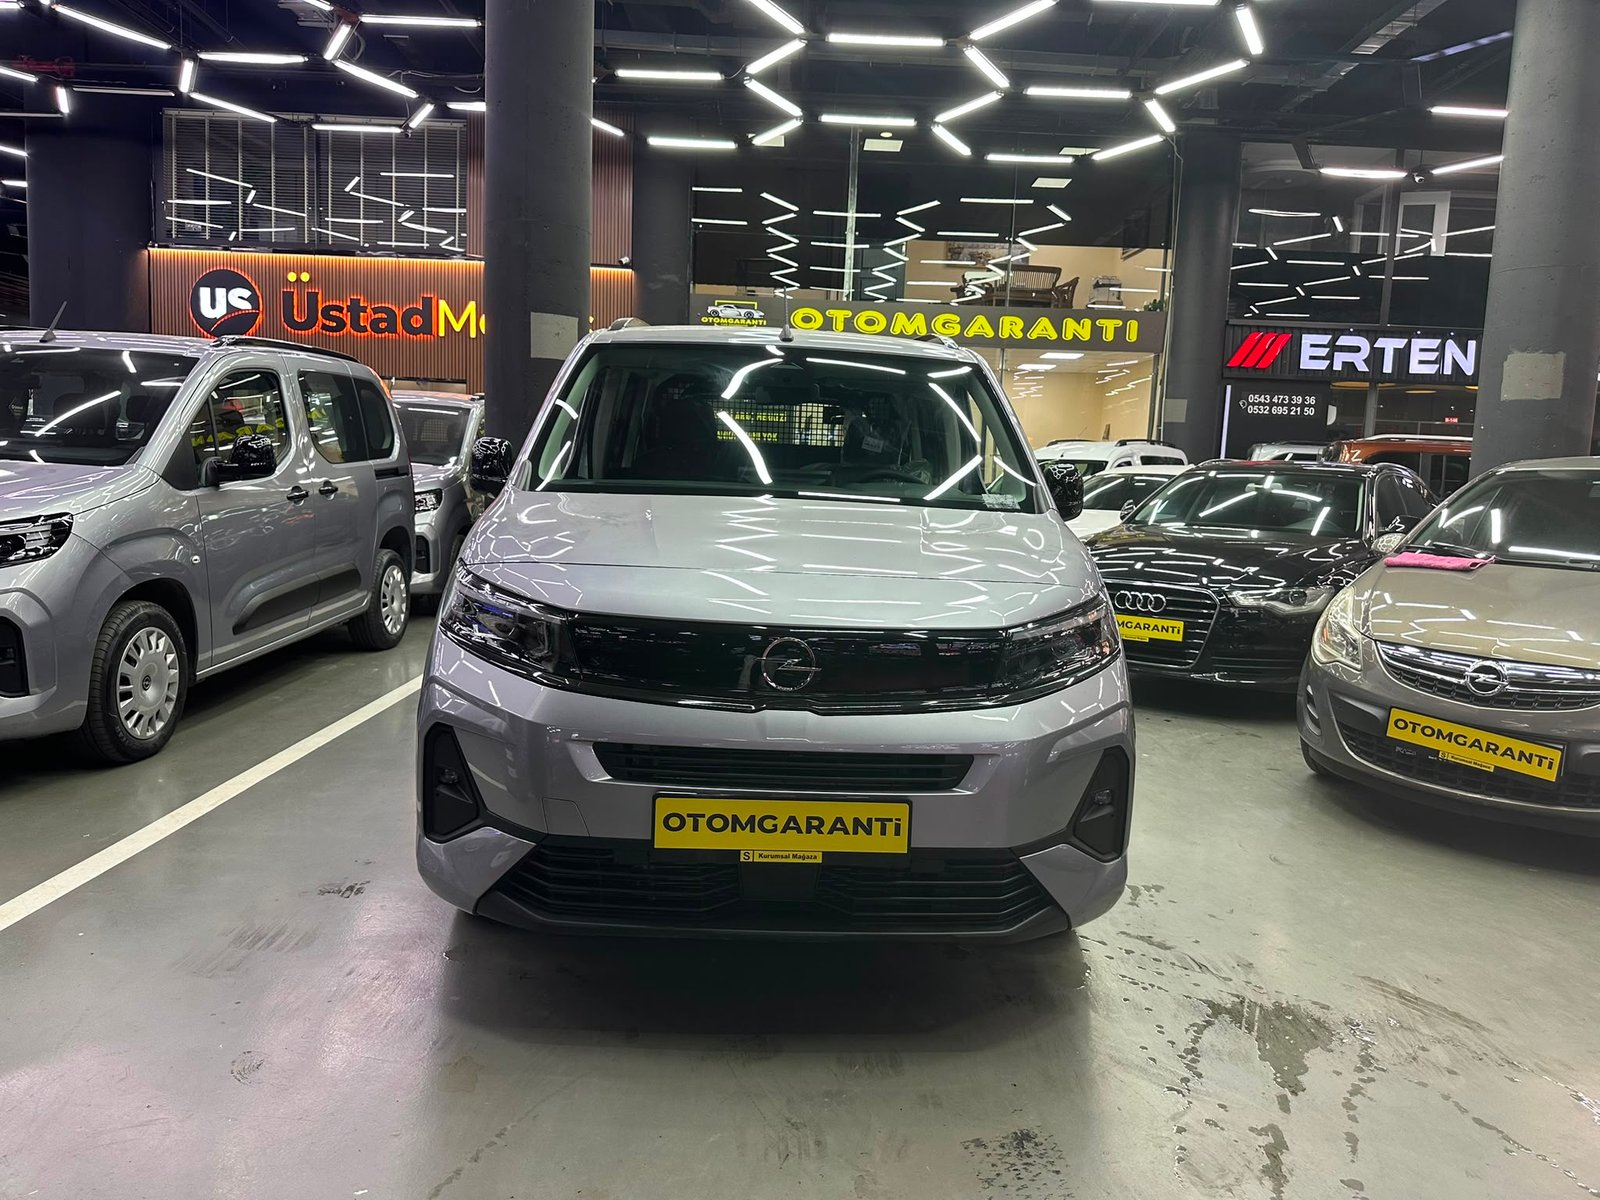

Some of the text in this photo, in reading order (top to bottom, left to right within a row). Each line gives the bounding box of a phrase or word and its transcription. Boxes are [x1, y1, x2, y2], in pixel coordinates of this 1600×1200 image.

[281, 271, 486, 338] ÜstadM
[701, 316, 767, 326] OTOMGARANTI
[790, 307, 1139, 343] OTOMGARANTI
[1299, 333, 1477, 376] ERTEN
[1248, 394, 1316, 405] 0543 473 39 36
[1247, 405, 1315, 416] 0532 695 21 50
[743, 851, 818, 861] S Kurumsal Mağaza
